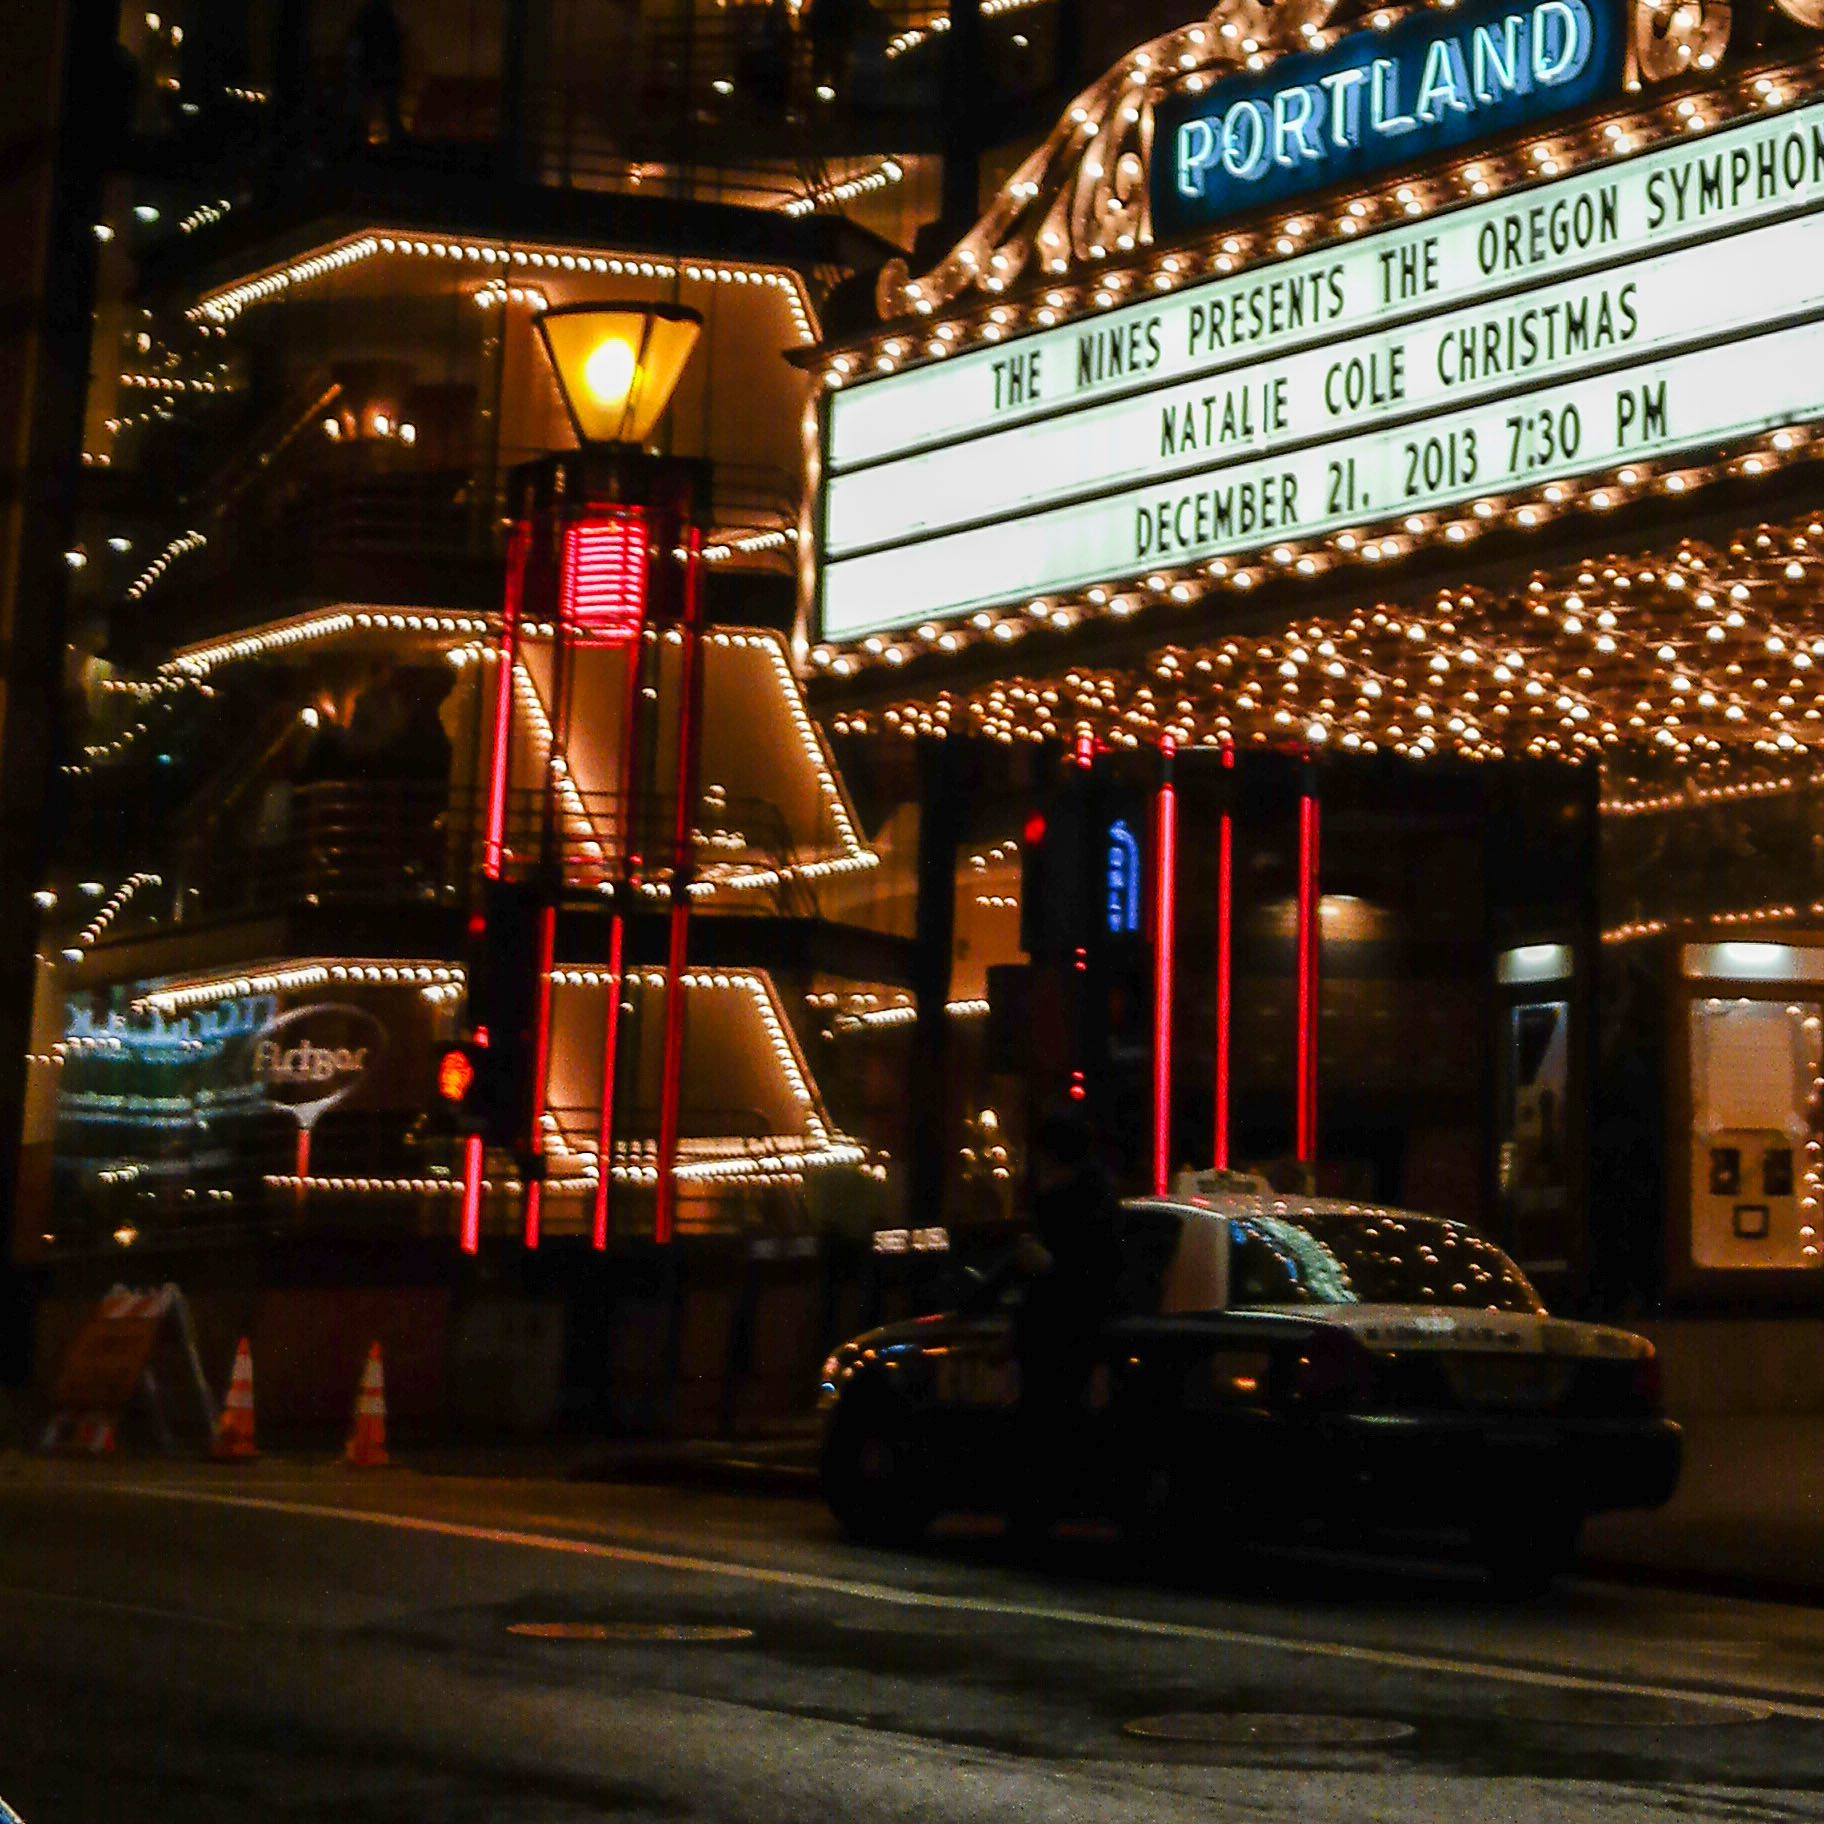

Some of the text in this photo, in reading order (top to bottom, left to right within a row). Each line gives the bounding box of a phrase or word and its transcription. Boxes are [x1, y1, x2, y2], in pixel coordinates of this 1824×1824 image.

[992, 351, 1041, 410] THE
[1077, 316, 1162, 388] NINES
[1188, 264, 1346, 357] PRESENTS
[1380, 235, 1440, 304] THE
[1477, 183, 1619, 275] OREGON
[1160, 283, 1639, 457] NATALIE COLE CHRISTMAS
[1135, 472, 1300, 558] DECEMBER
[1404, 427, 1480, 499] 2013
[1506, 402, 1582, 473] 7:30
[1615, 379, 1669, 449] PM
